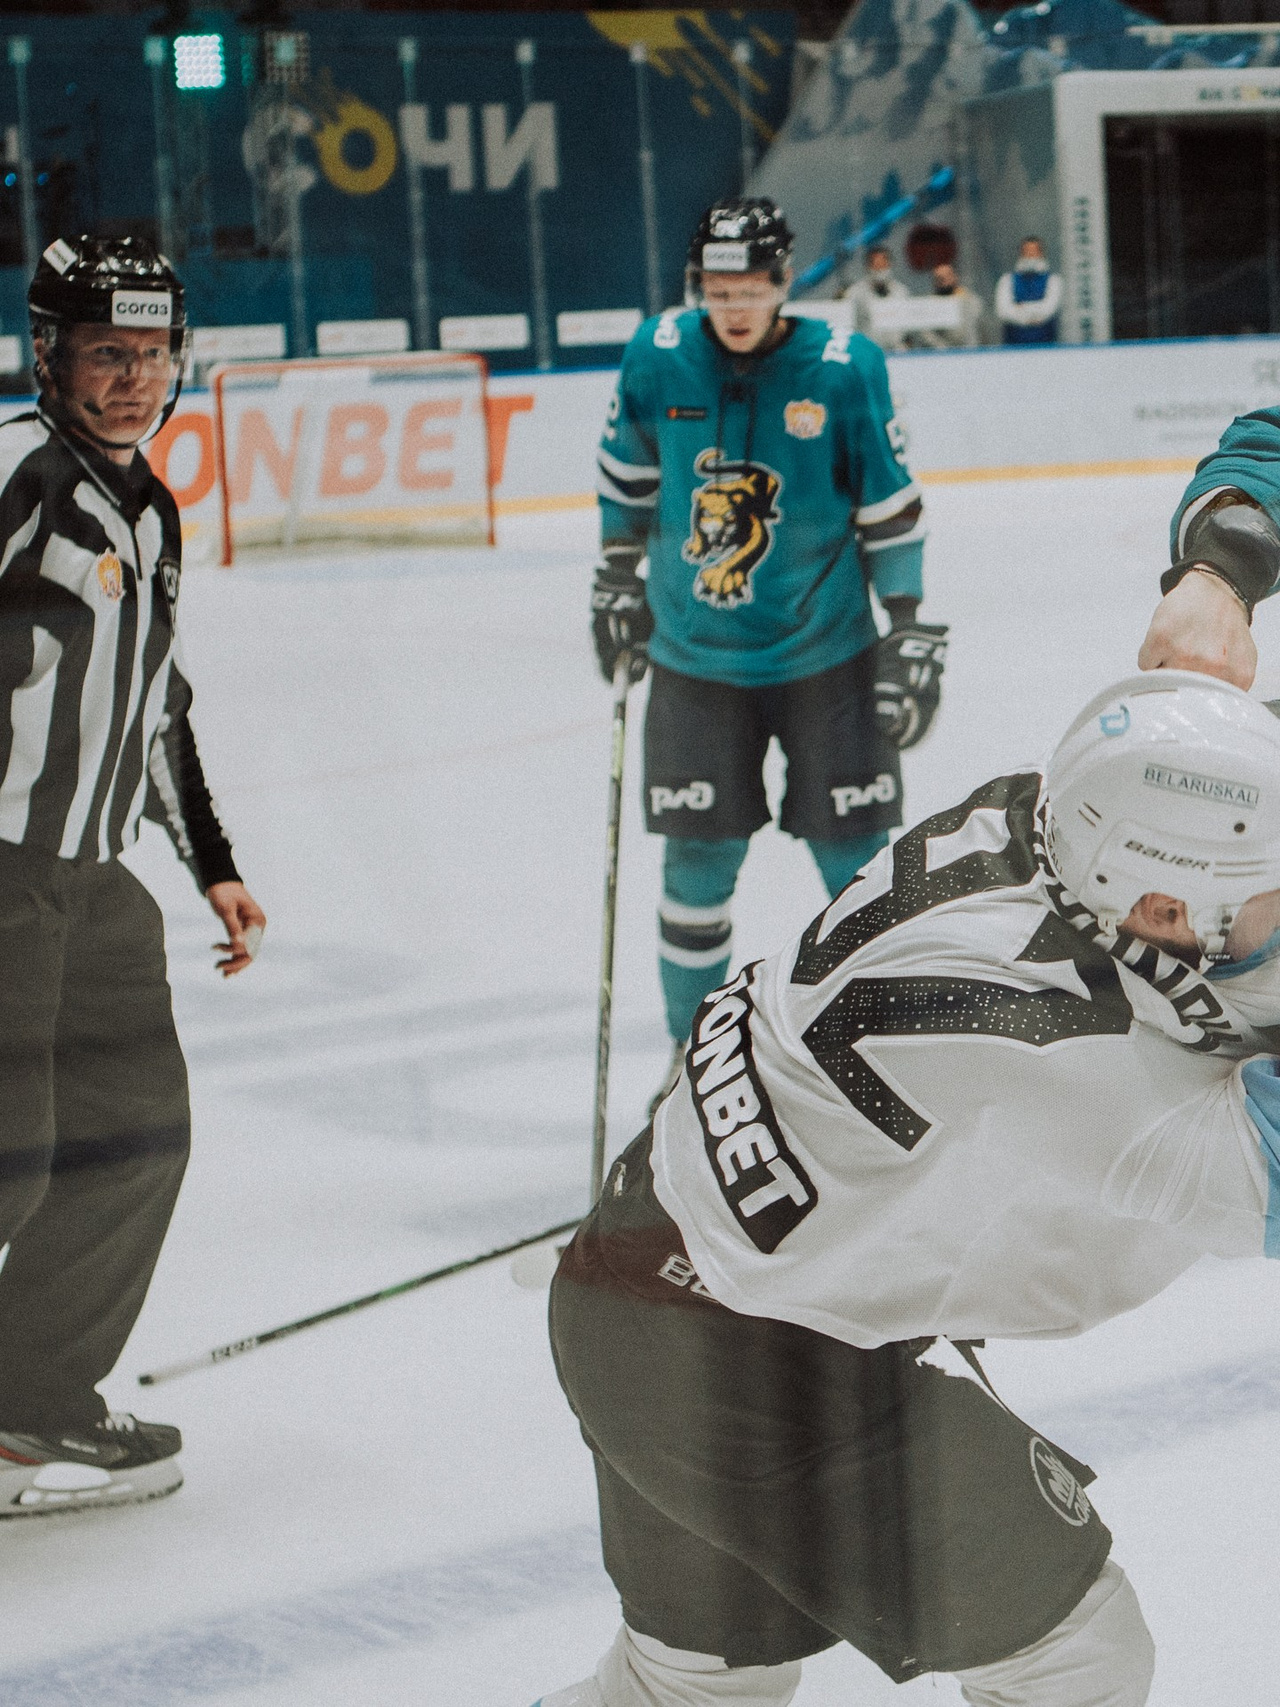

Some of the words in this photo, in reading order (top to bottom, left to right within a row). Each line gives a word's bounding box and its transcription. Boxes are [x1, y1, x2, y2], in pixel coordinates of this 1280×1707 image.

[242, 94, 559, 195] СОЧИ
[115, 301, 169, 316] согаз
[147, 394, 535, 508] ONBET
